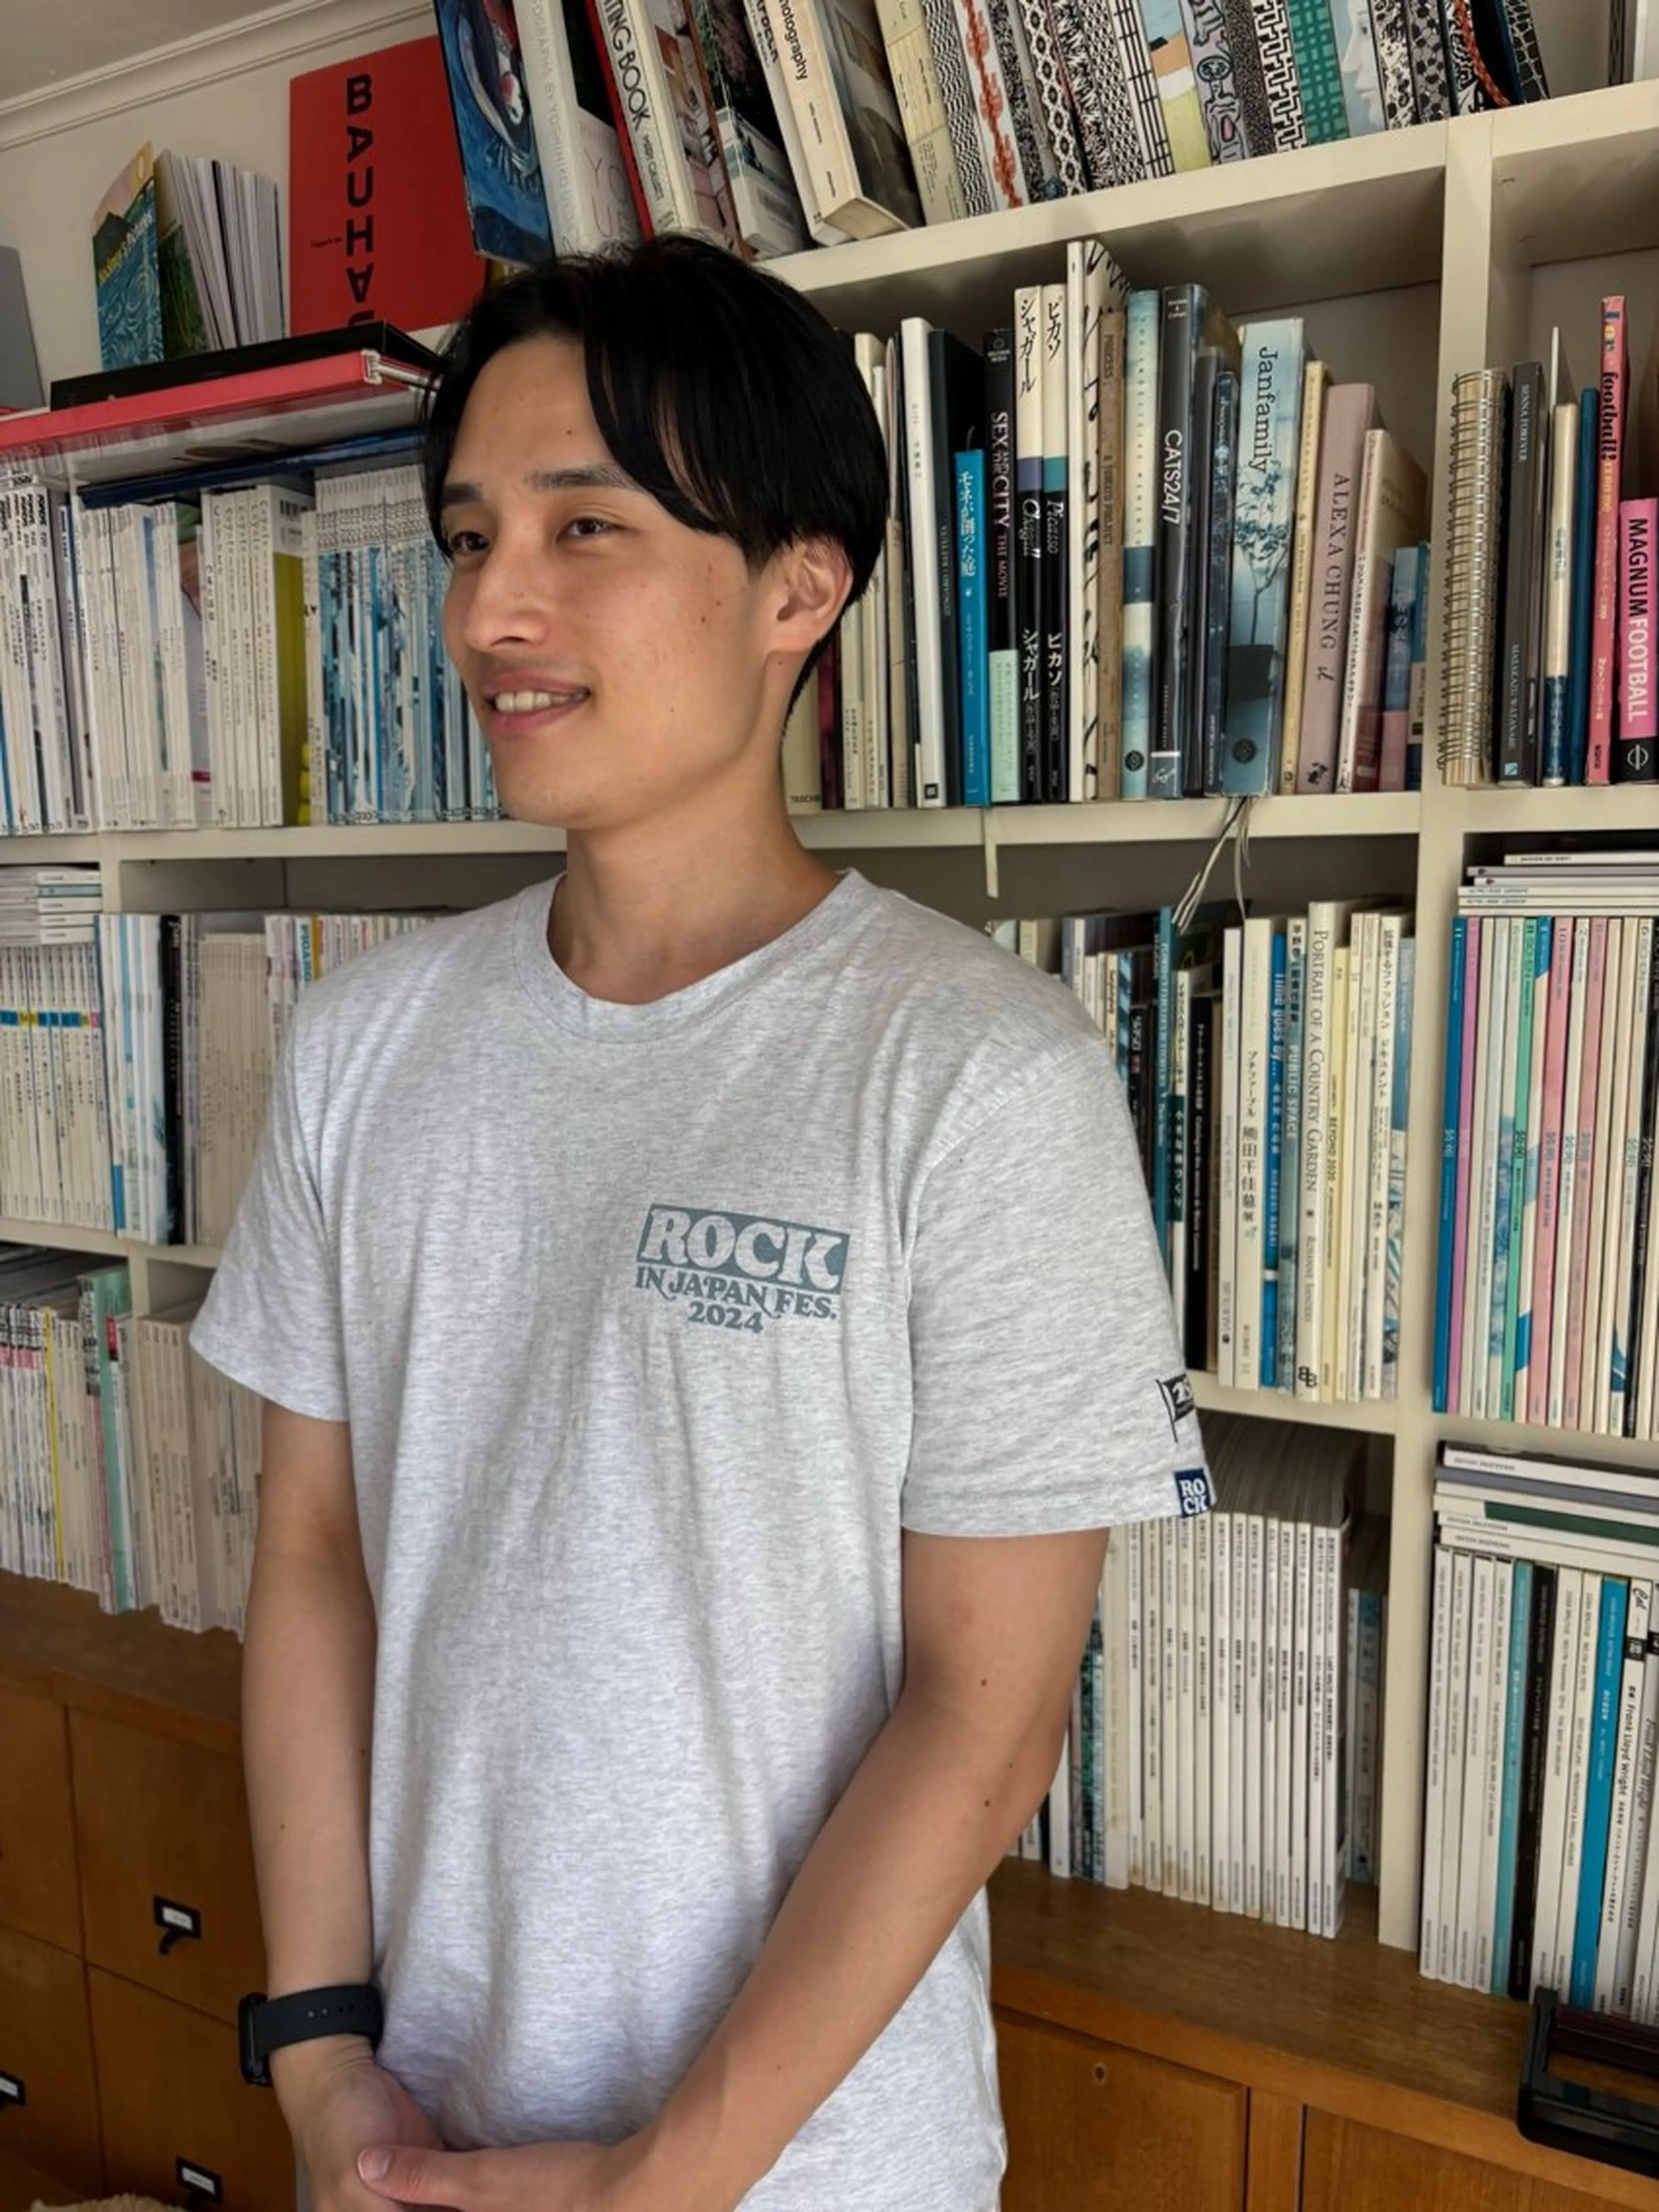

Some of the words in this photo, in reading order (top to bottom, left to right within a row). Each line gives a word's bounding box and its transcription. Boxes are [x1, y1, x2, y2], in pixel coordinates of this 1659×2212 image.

[602, 0, 631, 51] TING
[618, 49, 651, 130] BOOK
[1019, 299, 1037, 400] シャガール
[992, 411, 1008, 448] SEX
[1249, 346, 1278, 473] Janfamily
[1602, 372, 1618, 460] football!
[993, 475, 1010, 528] CITY
[1162, 429, 1183, 524] CATS24/7
[1046, 499, 1064, 554] Picasso
[1327, 472, 1351, 557] ALEXA
[996, 534, 1007, 557] THE
[1628, 518, 1648, 617] MAGNUM
[996, 559, 1007, 598] MOVIE
[1318, 563, 1344, 650] CHUNG
[1022, 628, 1039, 702] シャガール
[1627, 618, 1648, 723] FOOTBALL
[1288, 1044, 1299, 1093] PUBLIC
[1287, 1097, 1298, 1138] SPACE
[640, 1210, 841, 1291] ROCK
[635, 1265, 677, 1302] IN
[669, 1272, 782, 1319] JAPAN
[774, 1292, 837, 1320] FES.
[687, 1301, 764, 1334] 2024
[1624, 1703, 1636, 1732] Frank
[1620, 1733, 1633, 1761] Lloyd
[1617, 1761, 1630, 1796] Wright
